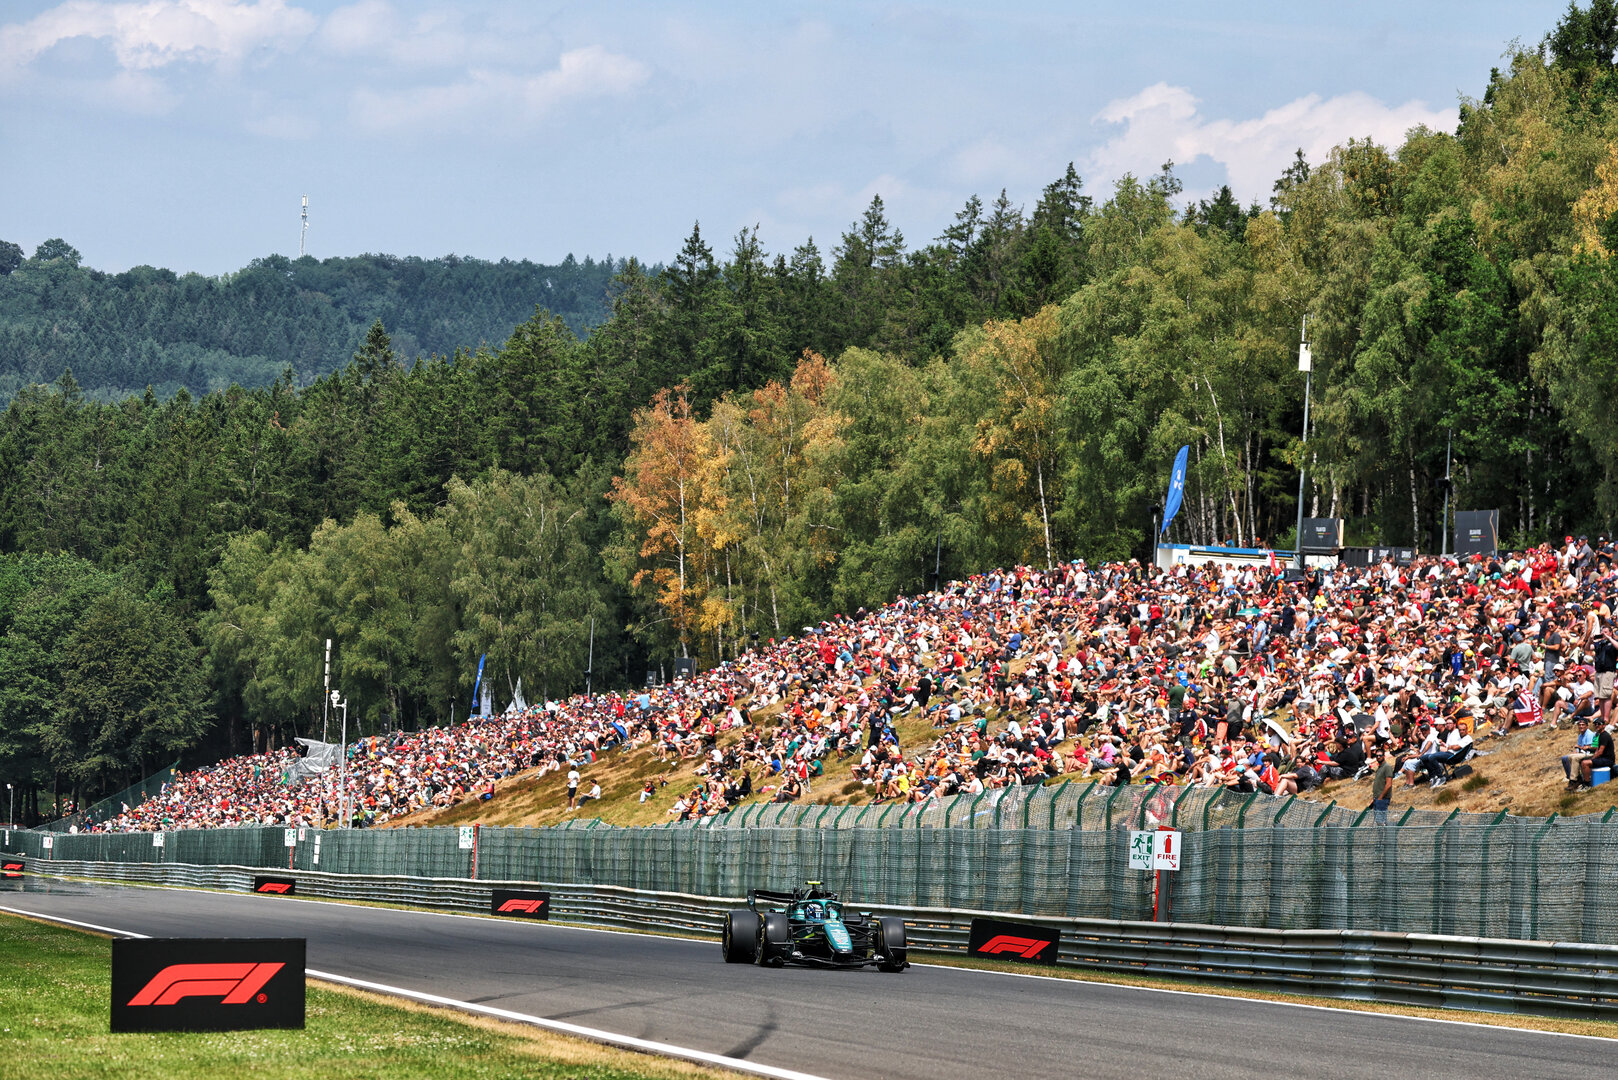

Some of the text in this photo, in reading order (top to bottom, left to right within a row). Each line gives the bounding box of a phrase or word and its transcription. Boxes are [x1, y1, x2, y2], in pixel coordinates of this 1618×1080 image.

[1132, 853, 1151, 861] EXIT
[1157, 853, 1177, 861] FIRE
[496, 898, 545, 913] F1
[977, 935, 1051, 959] F1
[126, 962, 286, 1006] F1
